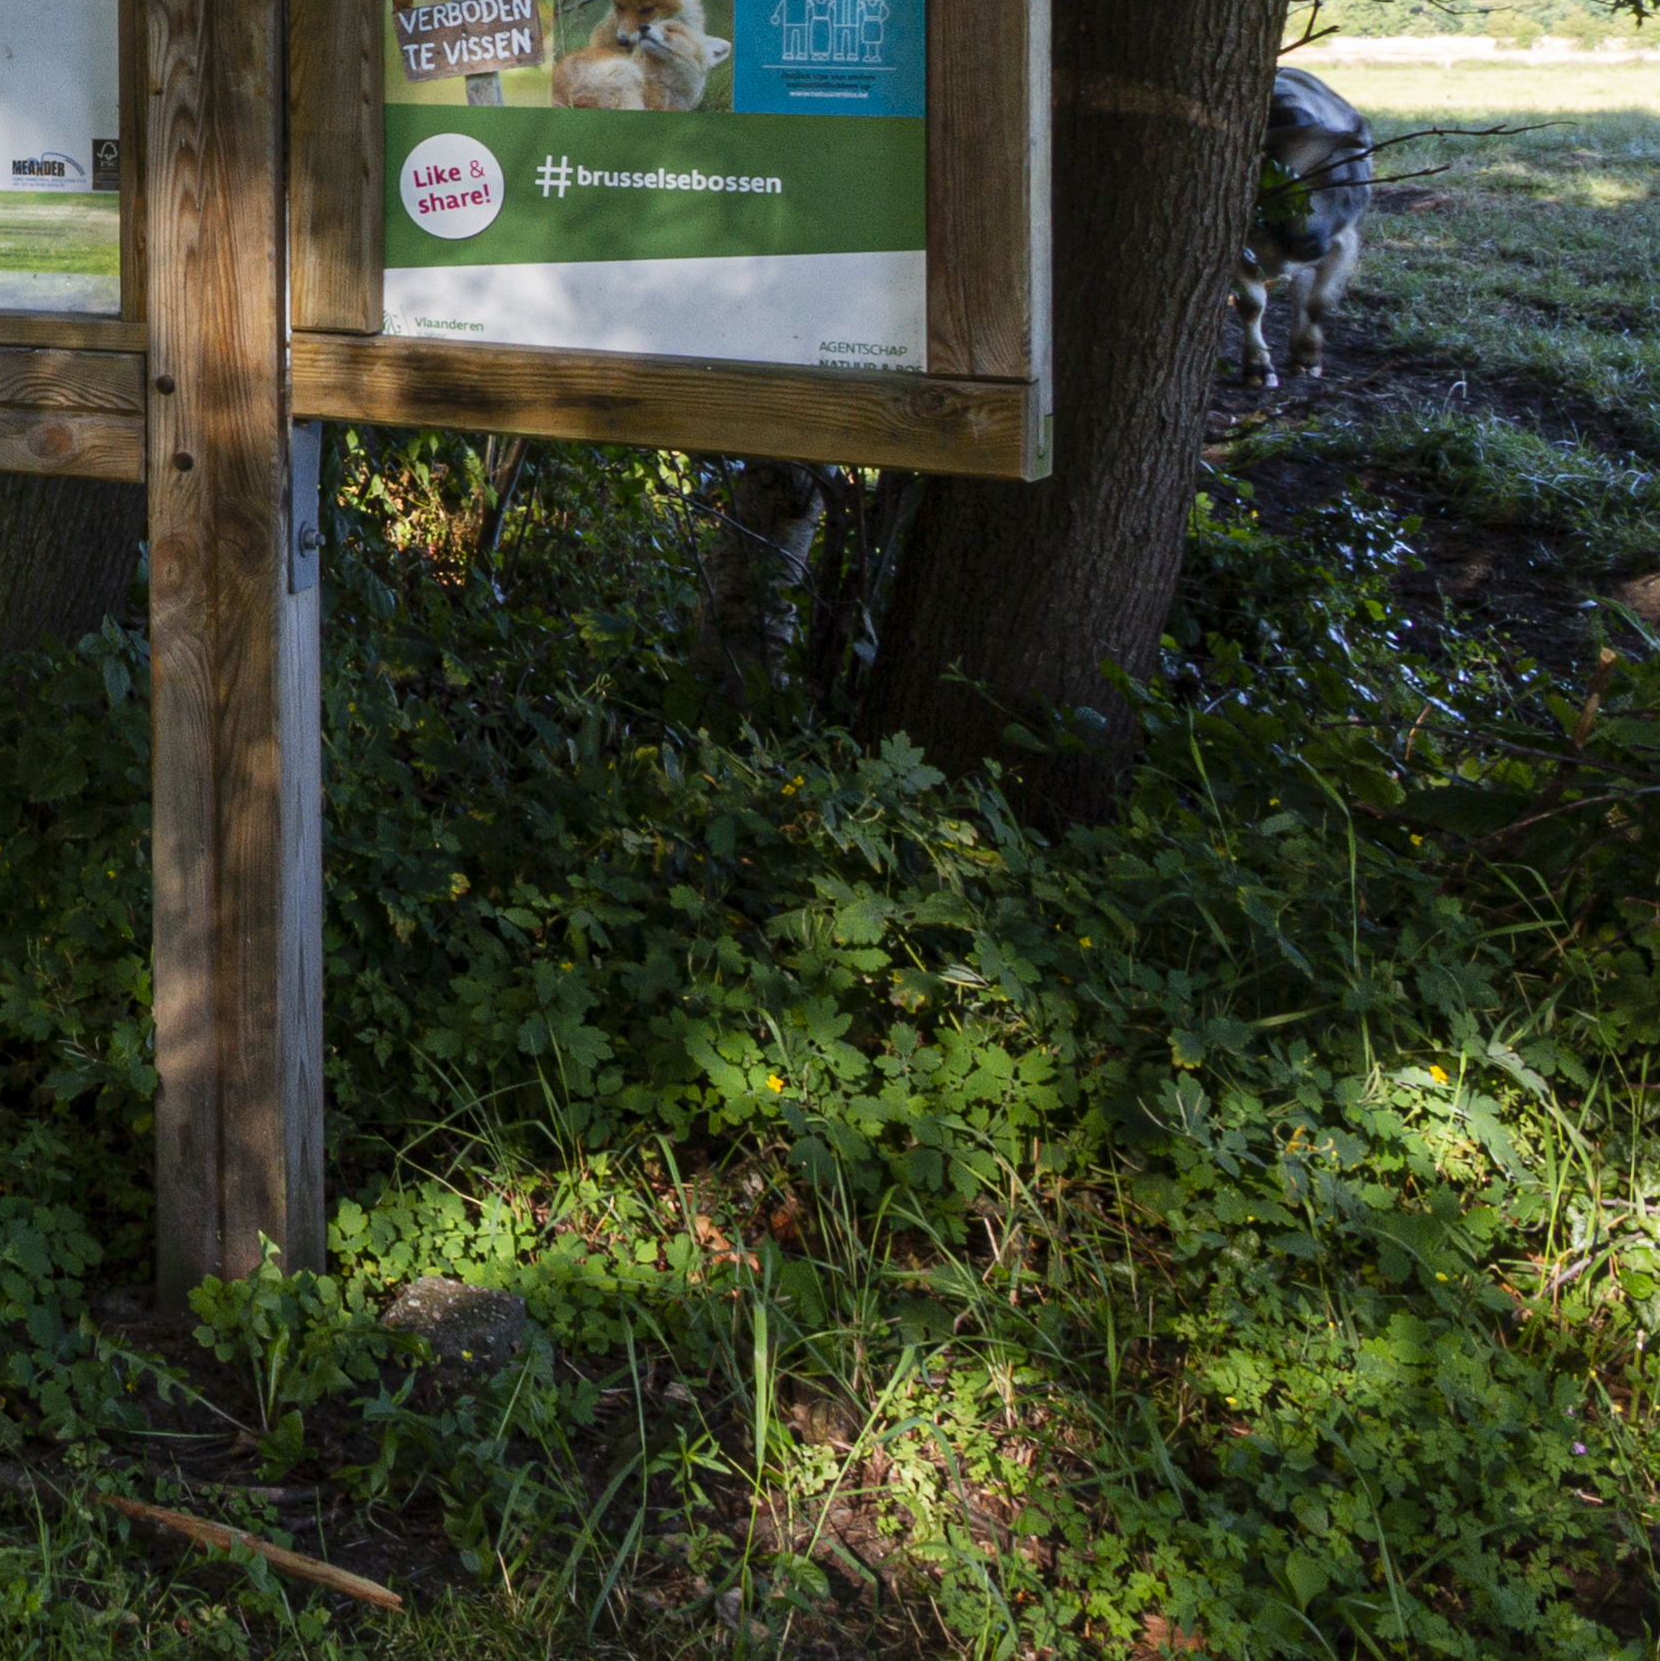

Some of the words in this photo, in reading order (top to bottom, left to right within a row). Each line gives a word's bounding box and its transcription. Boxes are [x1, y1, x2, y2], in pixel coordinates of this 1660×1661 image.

[402, 42, 436, 71] TE
[12, 160, 65, 177] MEANDER
[413, 165, 462, 190] Like
[469, 160, 485, 178] &
[534, 155, 783, 198] #brusselsebossen
[418, 184, 491, 214] share!
[414, 316, 484, 332] Vlaanderen
[818, 341, 908, 356] AGENTSCHAP
